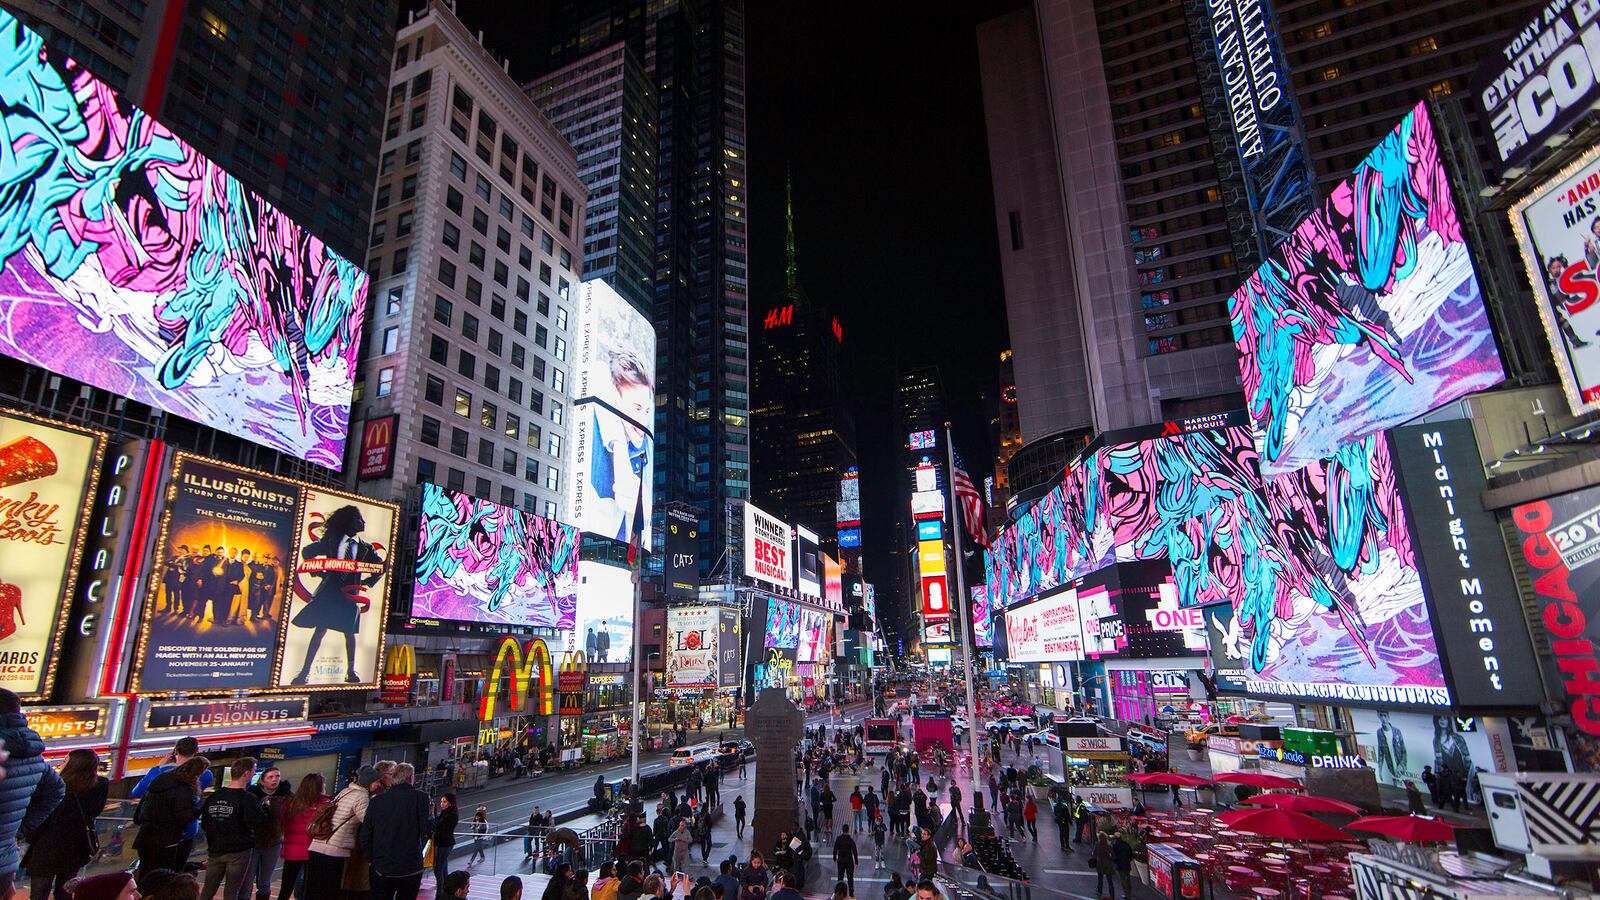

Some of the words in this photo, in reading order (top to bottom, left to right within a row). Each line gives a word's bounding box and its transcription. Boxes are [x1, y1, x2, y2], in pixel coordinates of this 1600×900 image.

[1504, 17, 1541, 61] TONY
[1543, 0, 1572, 25] AW
[1482, 17, 1575, 112] CYNTHIA
[1221, 29, 1264, 158] AMERICAN
[1490, 97, 1529, 162] THE
[1557, 170, 1600, 206] “AND
[1563, 197, 1597, 229] HAS
[585, 281, 593, 315] XPRESS
[1559, 260, 1600, 317] S
[582, 323, 591, 364] EXPRESS
[580, 371, 588, 411] EXPRES
[1184, 413, 1229, 425] MARRIOTT
[1185, 421, 1225, 431] MARQUIS
[367, 447, 386, 455] OPEN
[577, 421, 586, 464] EXPRESS
[362, 465, 386, 474] HOURS
[367, 454, 383, 466] 24
[184, 473, 295, 506] ILLUSIONISTS
[237, 478, 256, 488] THE
[232, 496, 249, 506] THE
[574, 471, 584, 519] EXPRESS
[0, 492, 60, 527] nky
[196, 508, 214, 517] THE
[215, 512, 278, 528] CLAIRVOYANTS
[754, 513, 785, 539] WINNER!
[1555, 524, 1587, 552] 20
[1583, 513, 1600, 534] Y
[80, 455, 128, 636] PALACE
[755, 538, 786, 568] BEST
[302, 561, 323, 570] FINAL
[324, 561, 355, 570] MONTHS
[673, 553, 694, 569] CATS
[755, 560, 787, 581] MUSICAL!
[1423, 431, 1470, 569] Midnight
[1460, 578, 1503, 690] Moment
[1086, 619, 1100, 634] ONE
[1155, 610, 1203, 627] ONE
[1512, 499, 1600, 736] CHICAGO
[1101, 620, 1124, 638] PRICE
[724, 649, 736, 664] CATS
[1044, 642, 1056, 653] BEST
[1056, 639, 1081, 653] MUSICAL
[0, 652, 39, 664] ARDS
[589, 675, 616, 684] EXPRESS
[1152, 673, 1188, 690] CITY
[1247, 681, 1300, 696] AMERICAN
[1303, 683, 1343, 699] EAGLE
[1346, 685, 1449, 706] OUTFITTERS
[169, 709, 289, 726] ILLUSIONISTS
[347, 720, 379, 729] MONEY
[1312, 755, 1363, 769] DRINK
